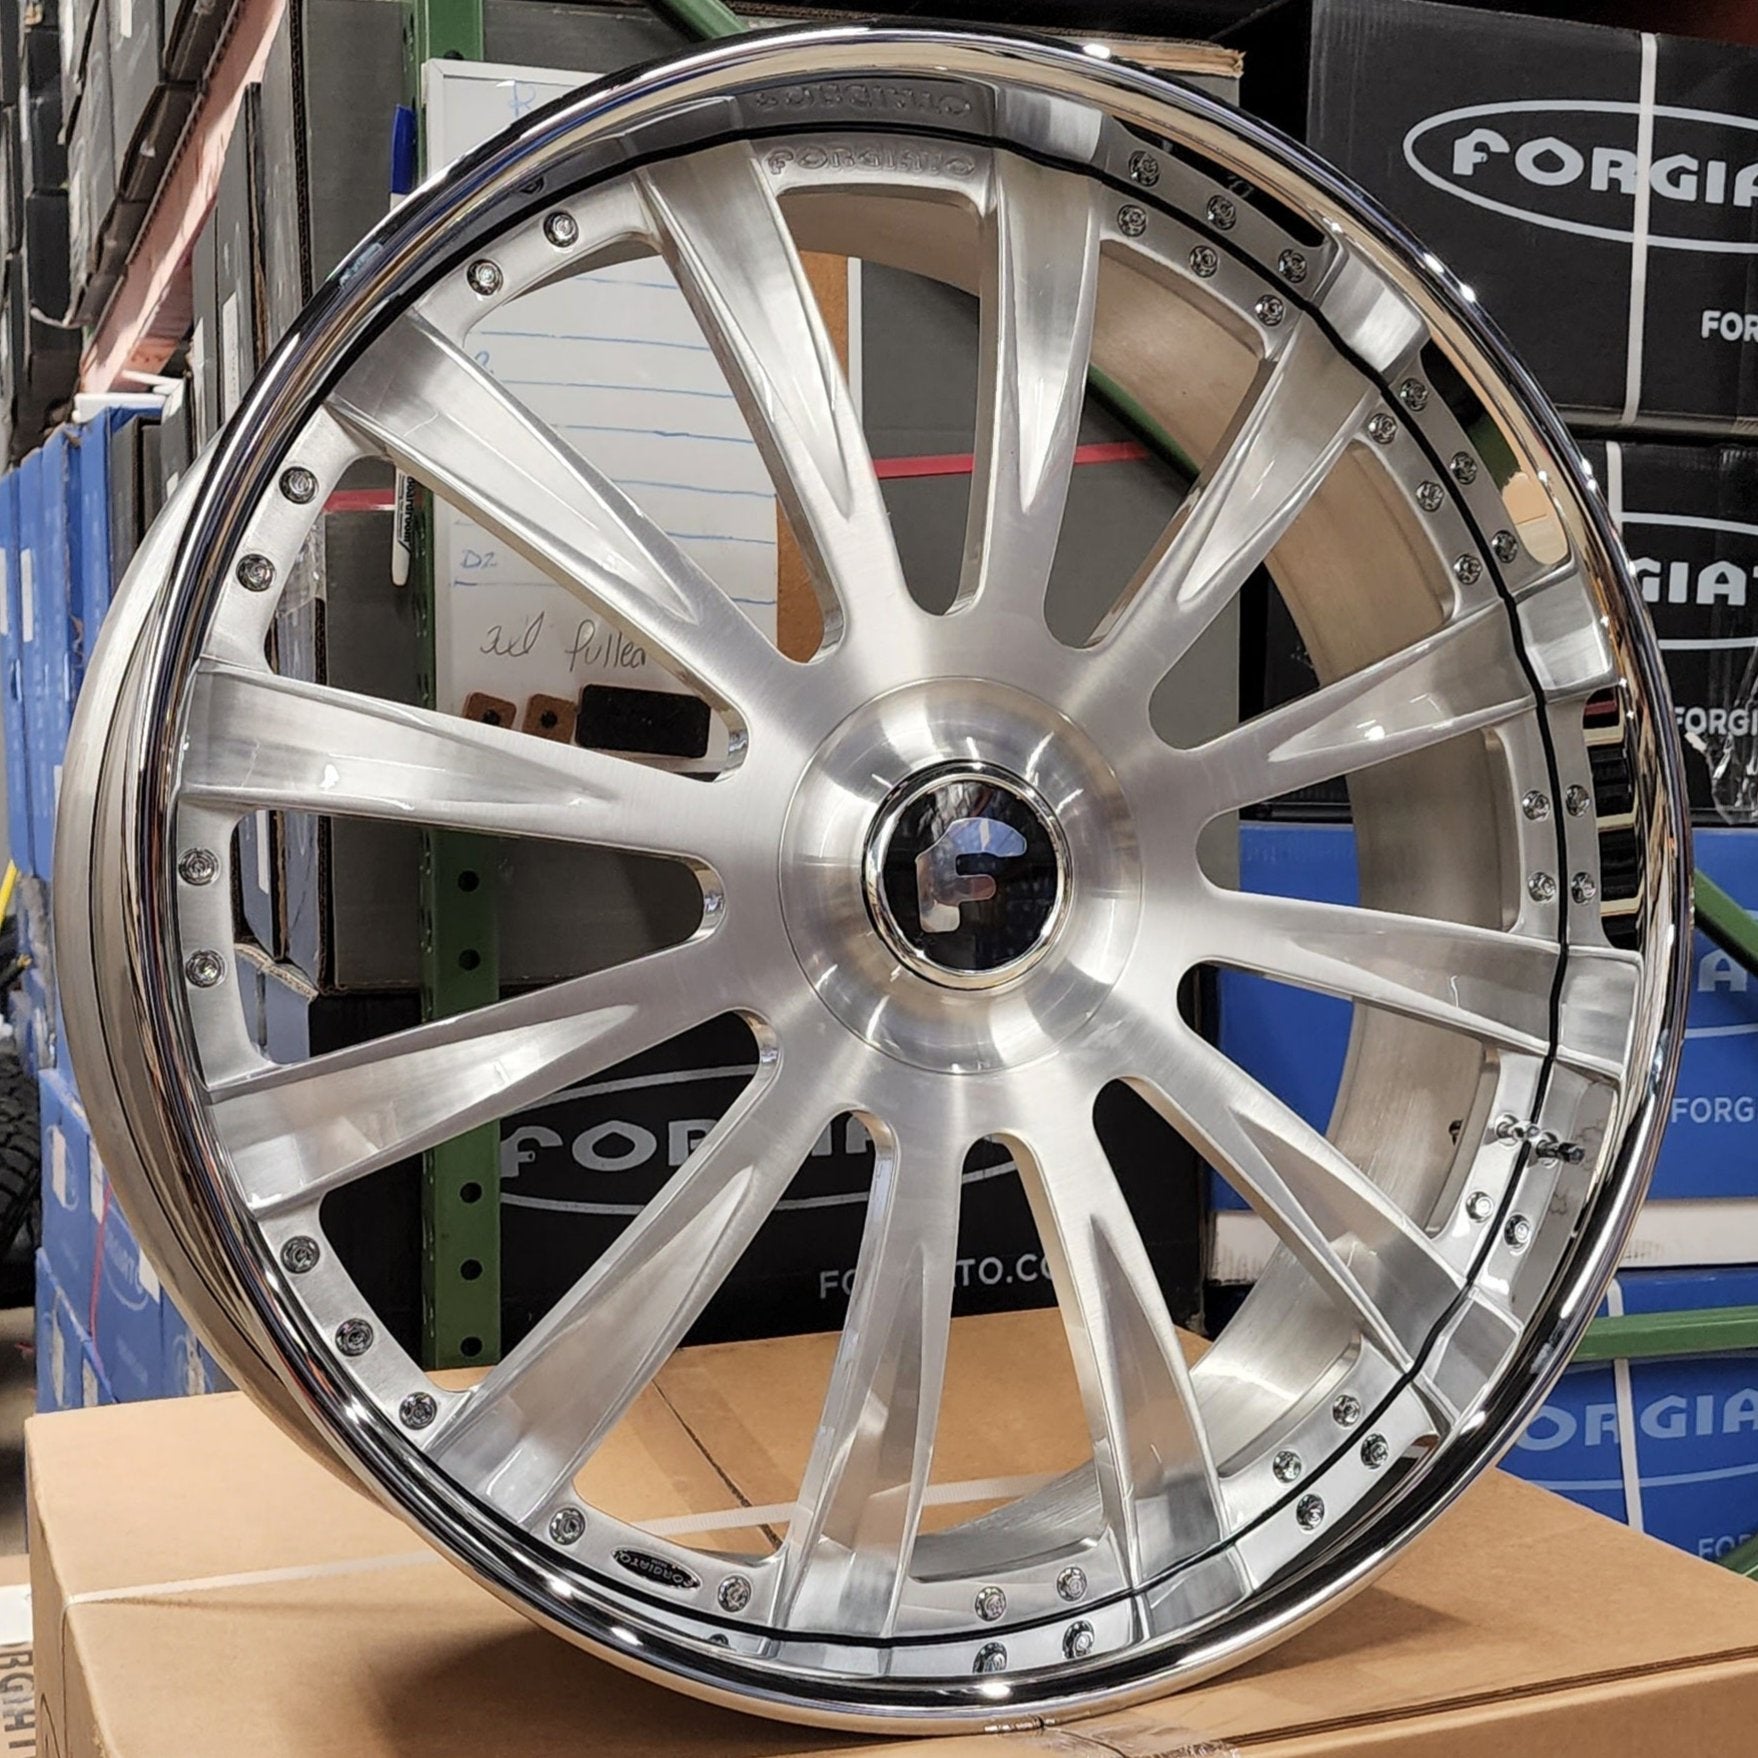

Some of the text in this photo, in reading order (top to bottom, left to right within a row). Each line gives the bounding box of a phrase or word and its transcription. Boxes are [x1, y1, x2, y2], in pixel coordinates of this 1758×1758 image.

[762, 149, 976, 176] FORGIATO
[1632, 557, 1758, 606] GIA
[1671, 1096, 1754, 1123] FORG
